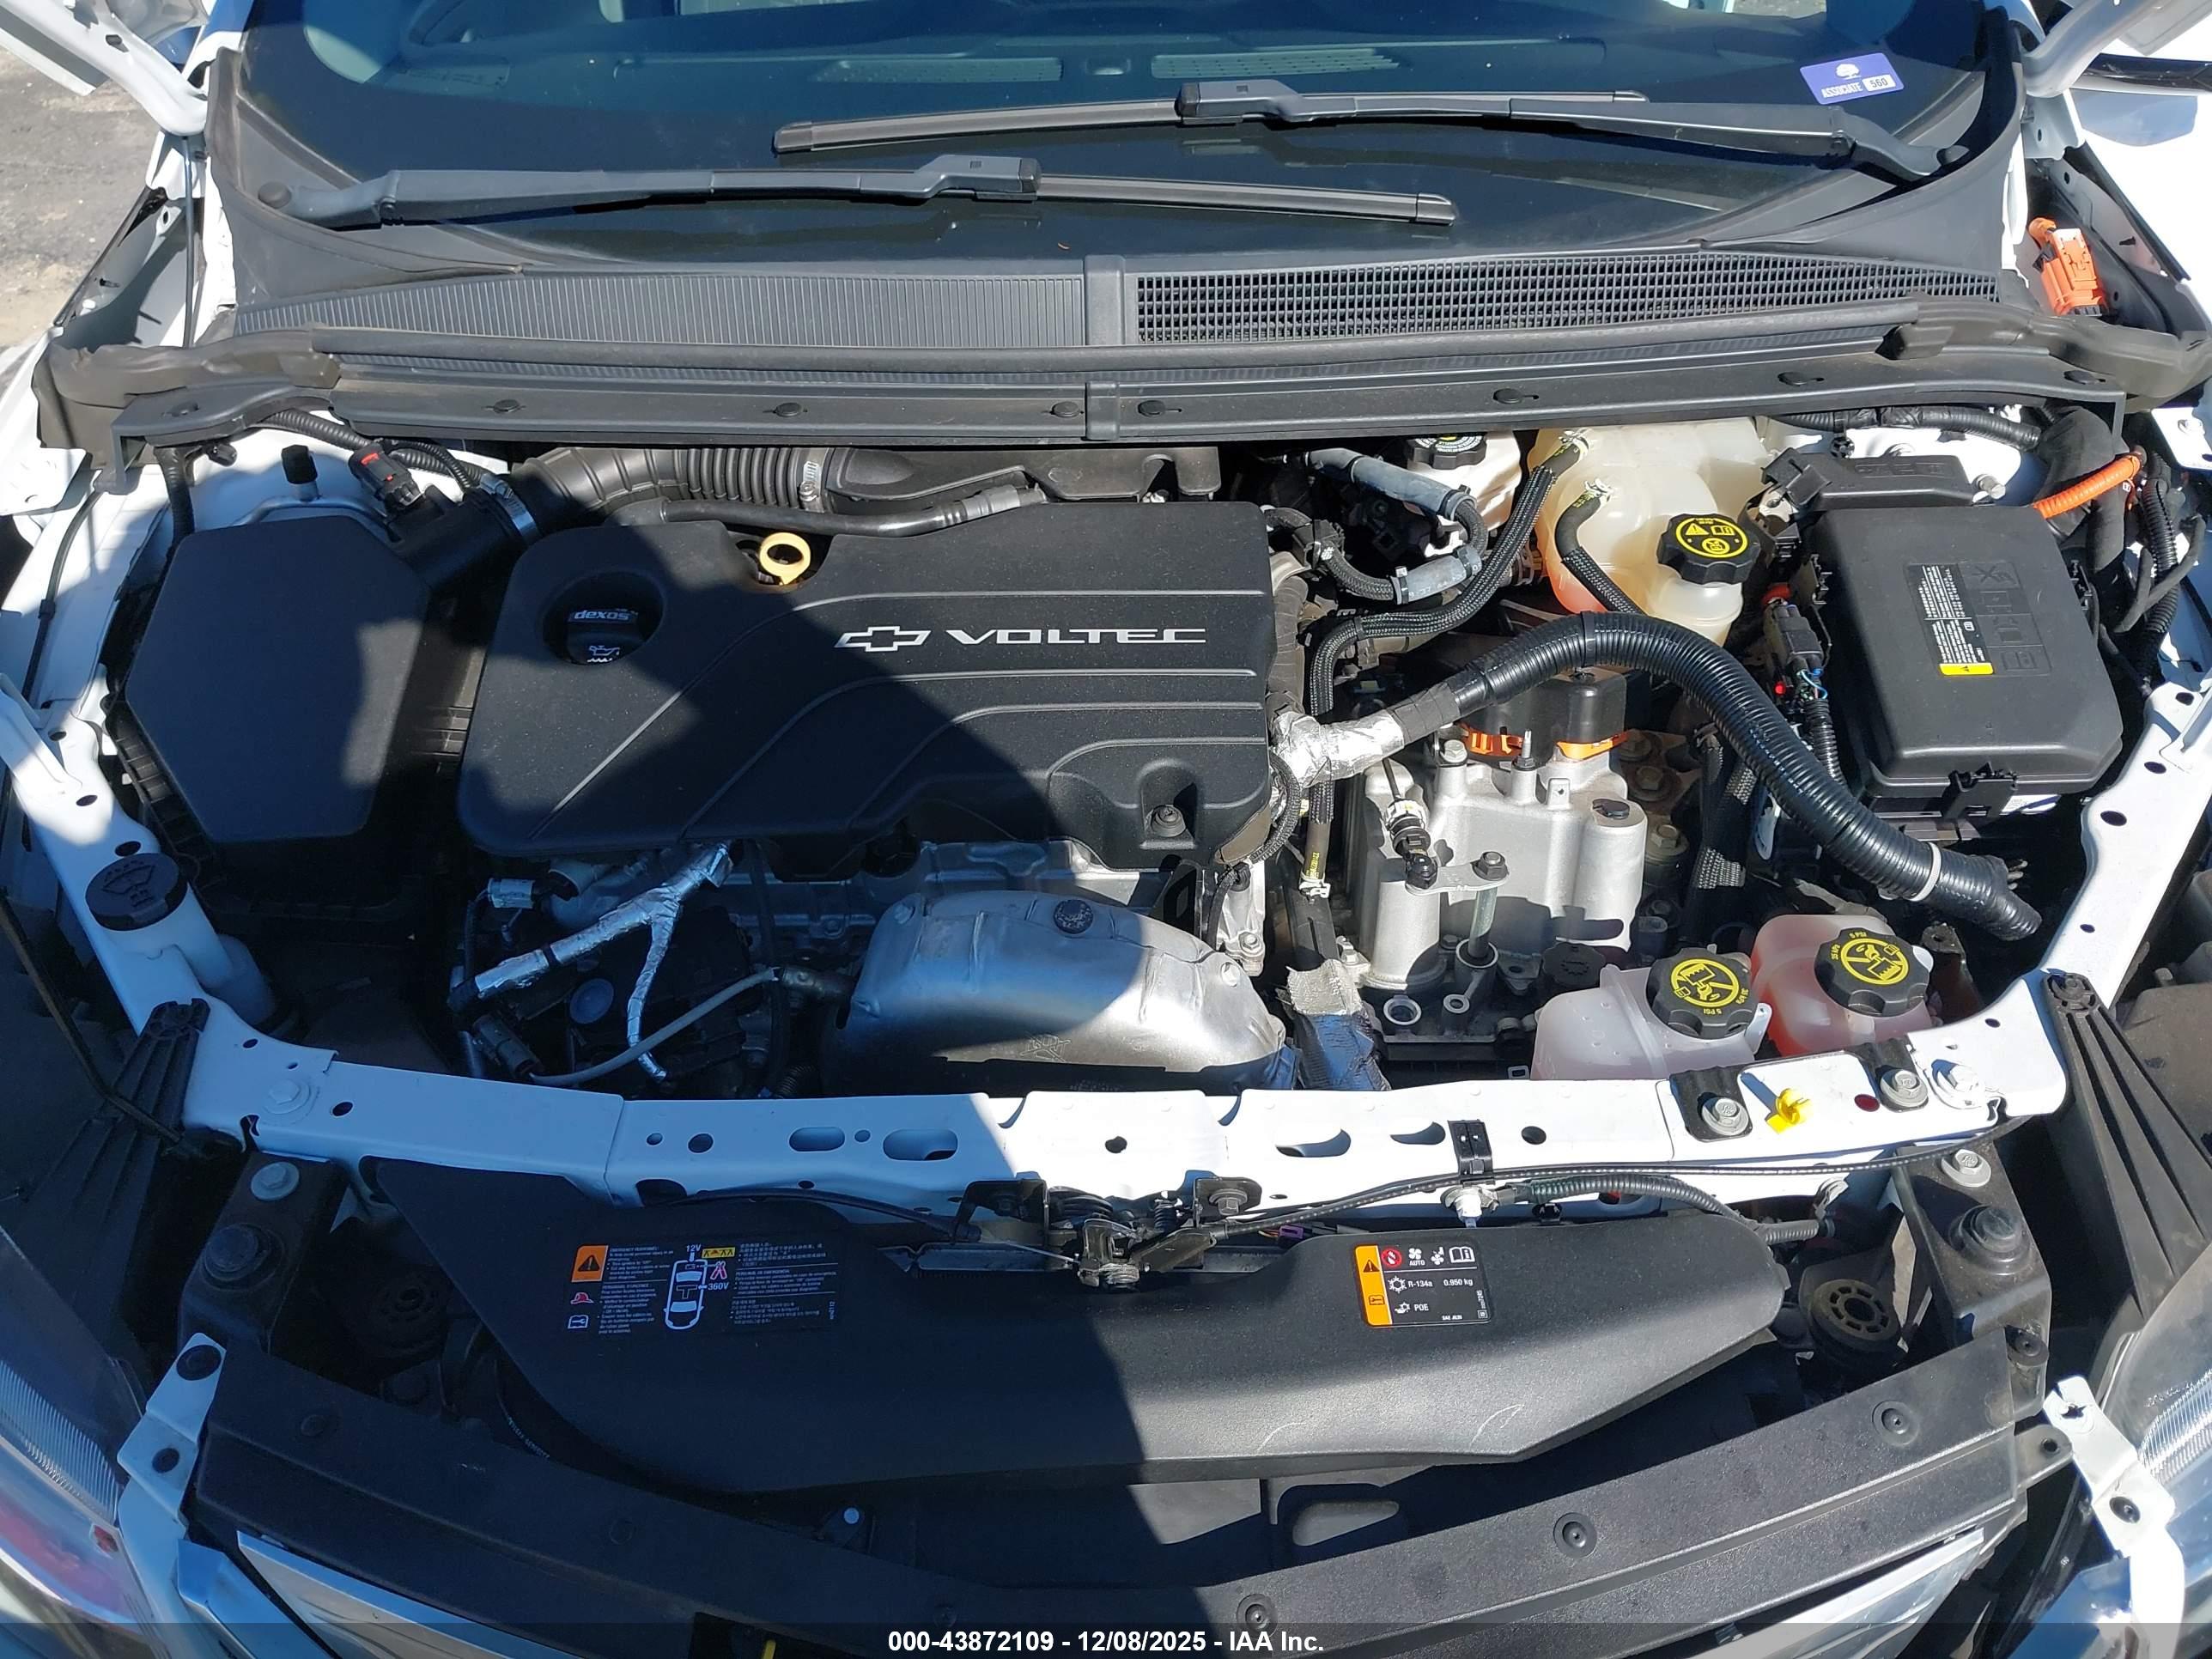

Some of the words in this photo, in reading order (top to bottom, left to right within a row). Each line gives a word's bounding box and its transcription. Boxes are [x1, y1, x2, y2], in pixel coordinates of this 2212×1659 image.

[1821, 82, 1863, 98] ASSOCIATE
[574, 610, 630, 620] dexos
[945, 629, 1206, 644] VOLTEC
[686, 1244, 702, 1253] 12V
[1464, 1279, 1474, 1287] kg
